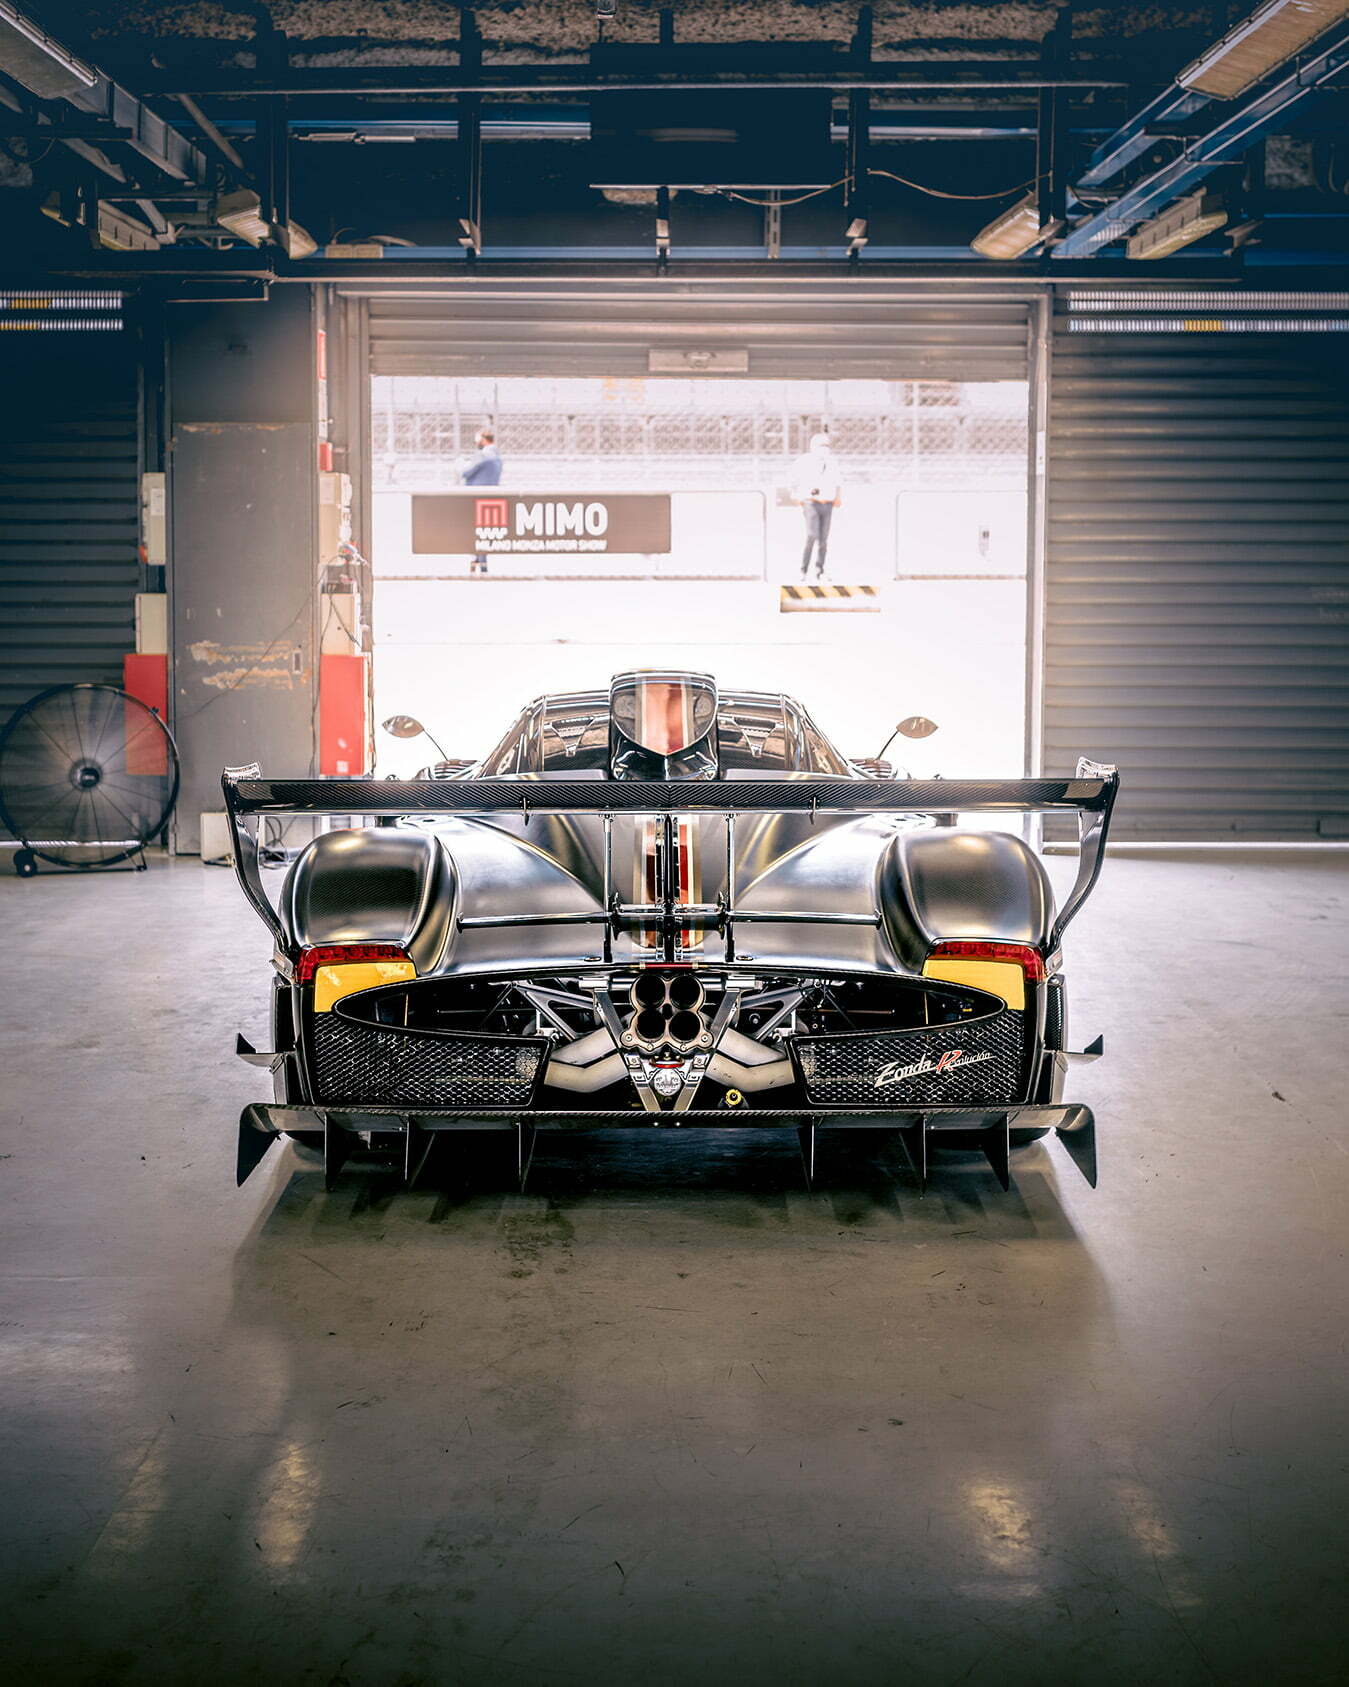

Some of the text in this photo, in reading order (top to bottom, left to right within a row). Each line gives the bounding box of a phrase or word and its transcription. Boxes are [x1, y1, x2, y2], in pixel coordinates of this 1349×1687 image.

[515, 502, 608, 536] MIMO
[475, 540, 511, 551] MILANO
[546, 540, 577, 551] MOTOR
[579, 540, 607, 551] SHOW
[874, 1053, 934, 1088] Zonda
